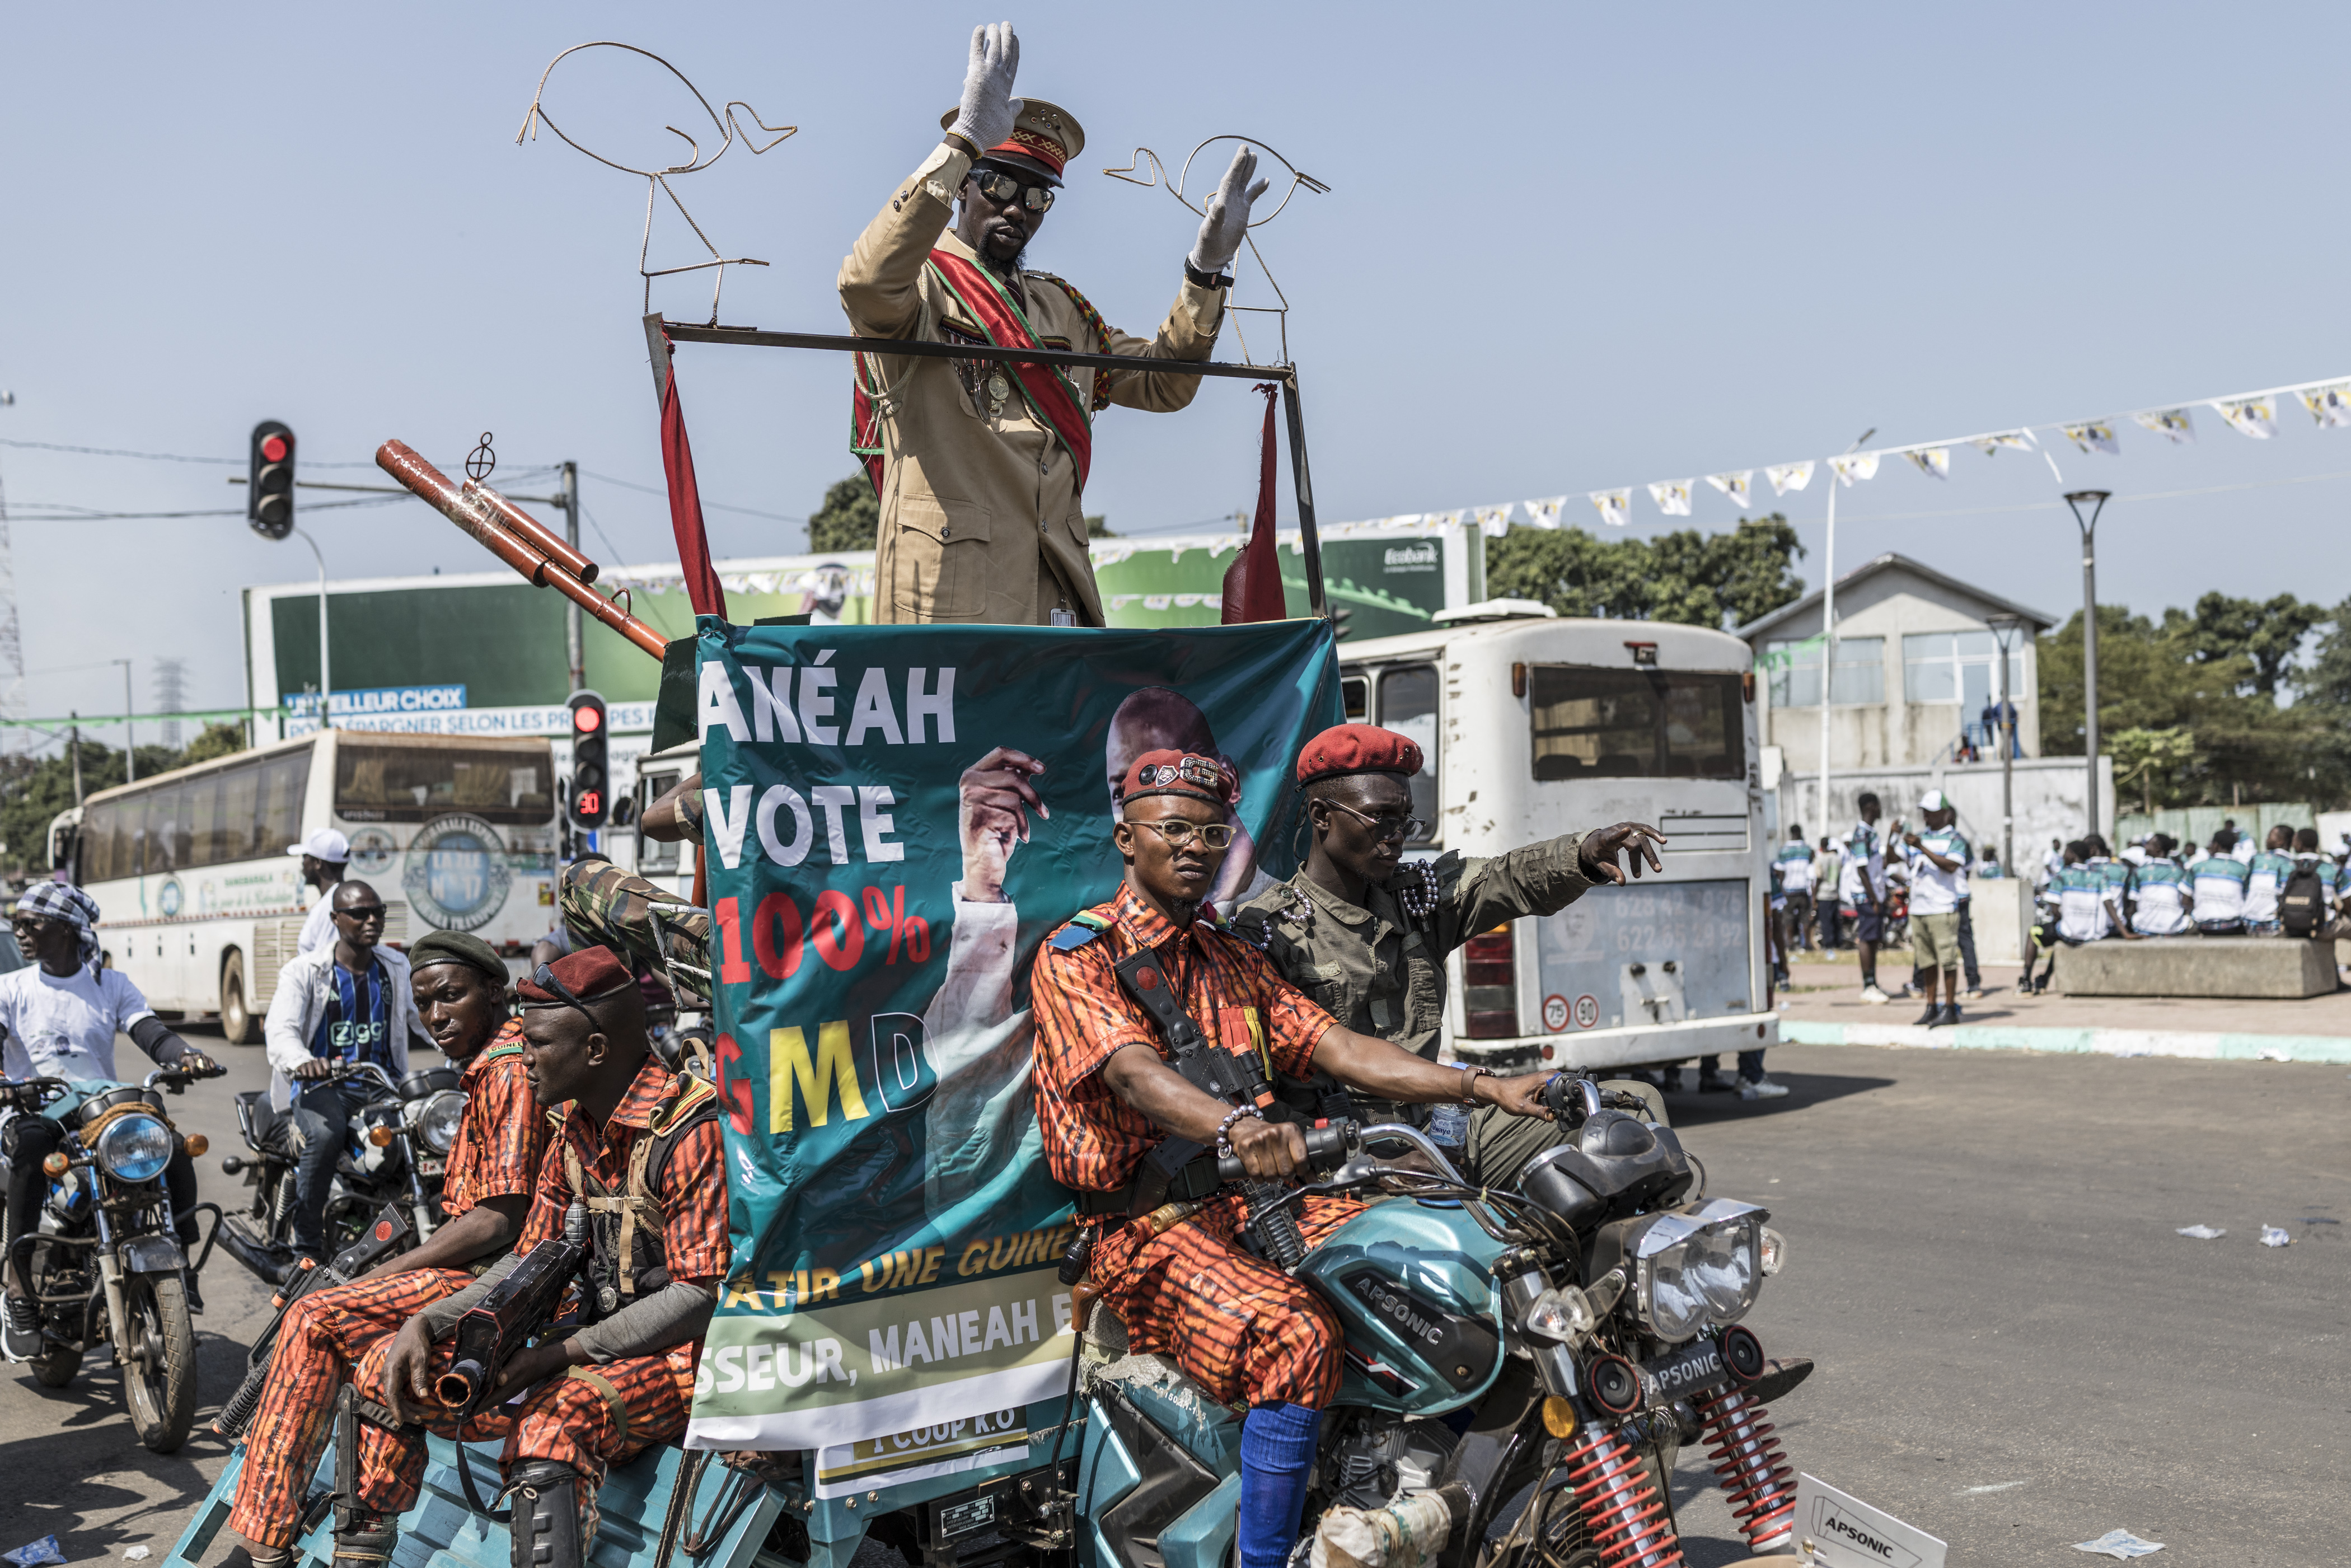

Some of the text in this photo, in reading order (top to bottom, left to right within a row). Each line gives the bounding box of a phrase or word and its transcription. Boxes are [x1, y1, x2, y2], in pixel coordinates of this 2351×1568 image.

[400, 688, 462, 711] CHOIX
[698, 649, 956, 746] ANÉAH
[448, 713, 504, 733] SELON
[512, 711, 542, 730] LES
[580, 793, 599, 813] 30
[703, 785, 905, 869] VOTE
[715, 885, 931, 985] 100%
[1617, 925, 1656, 951] 622
[1548, 1005, 1565, 1019] 75
[1580, 1003, 1594, 1021] 90
[1431, 1125, 1451, 1135] awaye
[717, 1214, 1080, 1310] ATIR UNE GUINÉ
[1355, 1277, 1443, 1346] APSONIC
[869, 1299, 1039, 1374] MANEAH
[1648, 1352, 1721, 1395] APSONIC
[892, 1419, 966, 1449] COUP
[1825, 1516, 1893, 1559] APSONIC
